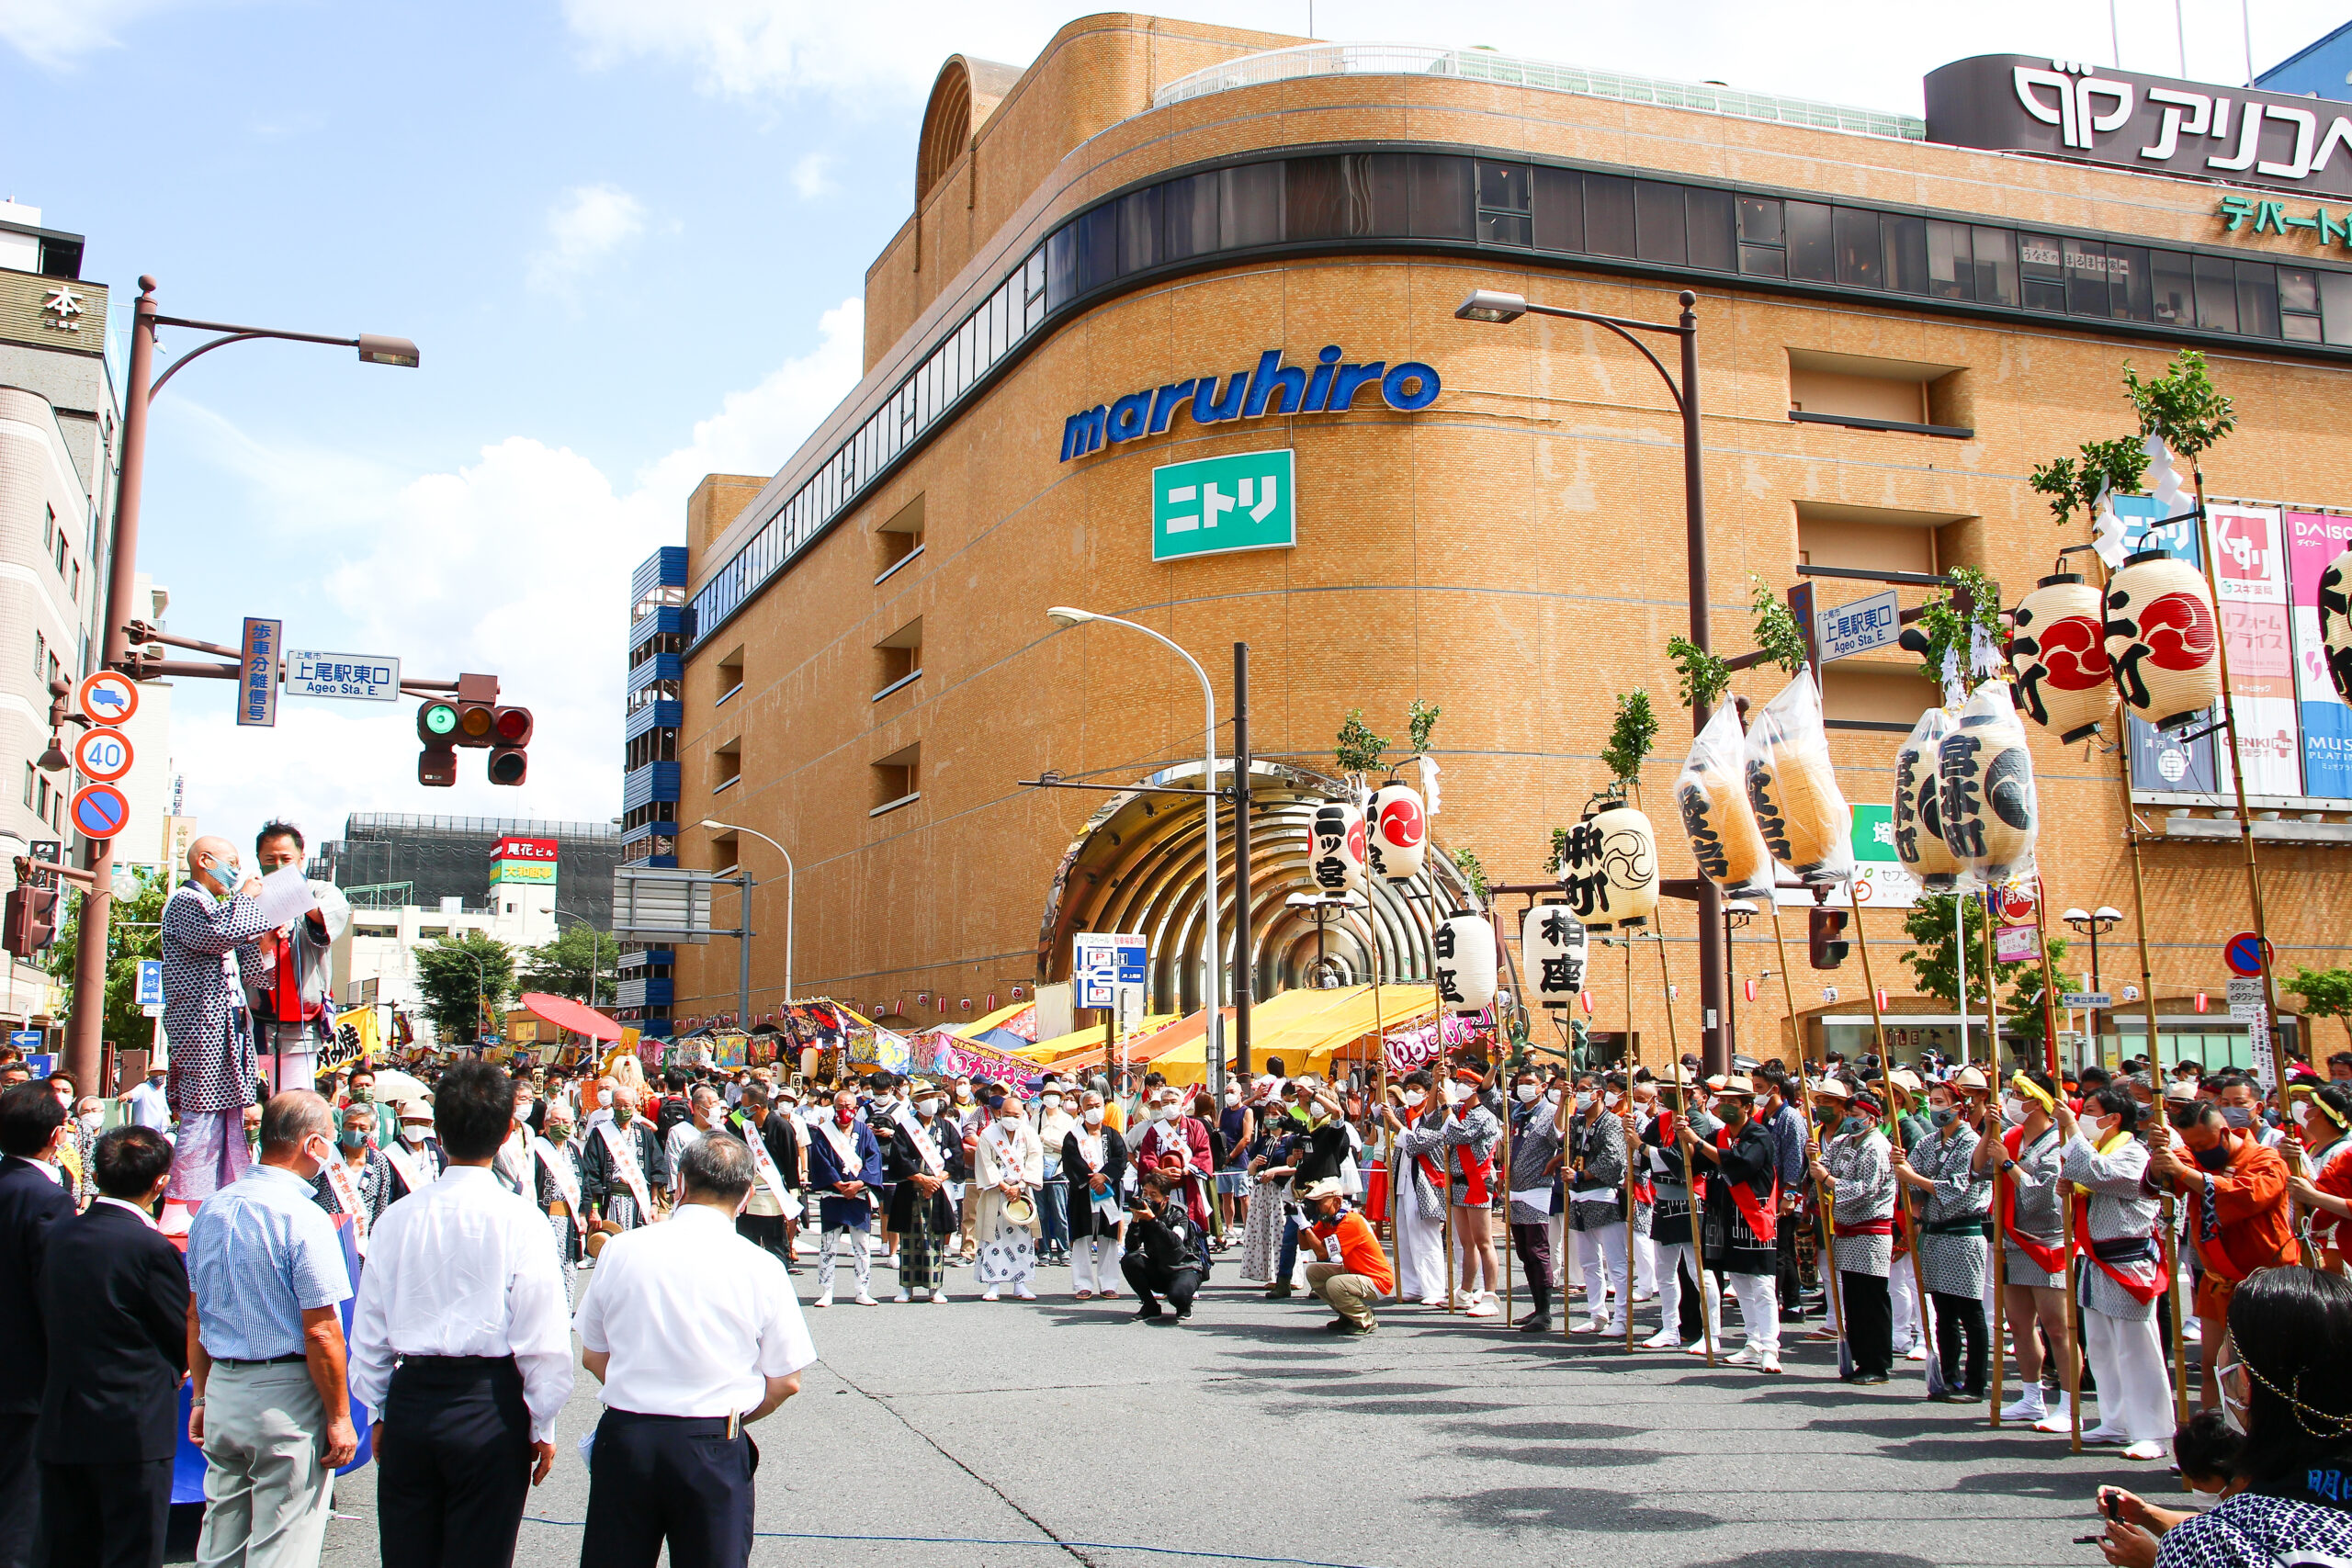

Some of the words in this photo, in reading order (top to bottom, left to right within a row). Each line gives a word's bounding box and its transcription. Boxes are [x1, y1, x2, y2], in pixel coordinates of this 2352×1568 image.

[2221, 196, 2352, 246] デパート
[44, 286, 84, 317] 本
[1060, 345, 1442, 464] maruhiro
[1166, 475, 1277, 535] ニトリ
[2217, 517, 2270, 579] くすり
[2297, 538, 2323, 547] ダイソー
[2233, 583, 2273, 595] スギ薬局
[1822, 608, 1841, 621] 上尾市
[1825, 604, 1892, 643] 上尾駅東口
[1834, 642, 1855, 653] Ageo
[1858, 633, 1875, 647] Sta.
[1877, 628, 1886, 641] E.
[296, 651, 322, 660] 上尾市
[247, 624, 272, 721] 歩車分離信号
[295, 661, 390, 685] 上尾駅東口
[306, 682, 336, 694] Ageo
[341, 682, 364, 695] Sta.
[368, 685, 379, 696] E.
[87, 742, 120, 767] 40
[506, 842, 555, 858] 尾花ビル
[1314, 807, 1348, 888] 二ツ宮
[1080, 936, 1110, 944] アリコベール
[1114, 936, 1145, 945] 駐車場案内図
[1541, 908, 1584, 995] 柏座
[1096, 988, 1105, 997] P
[2229, 982, 2265, 991] タクシープー
